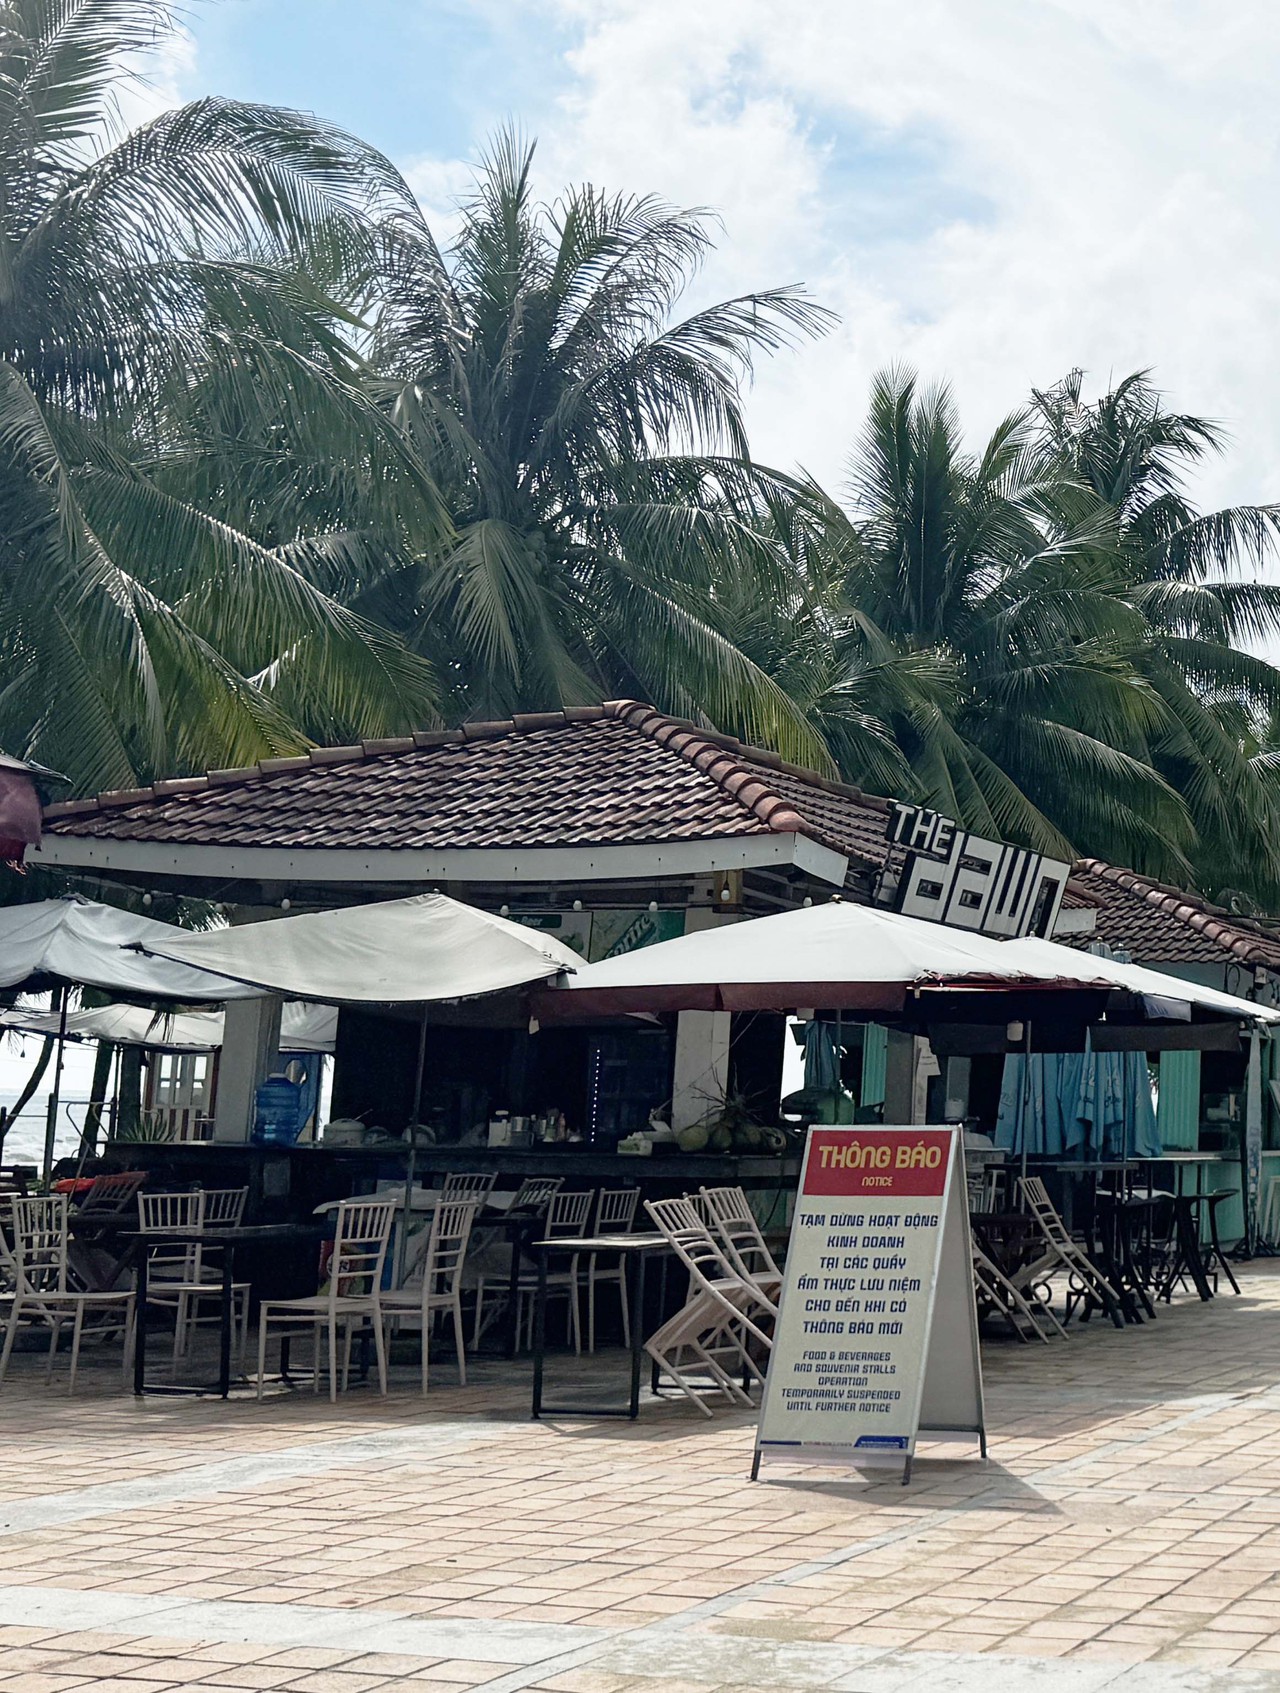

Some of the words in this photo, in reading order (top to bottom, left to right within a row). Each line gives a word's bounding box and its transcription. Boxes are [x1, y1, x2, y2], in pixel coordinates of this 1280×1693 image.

[893, 803, 955, 855] THE
[819, 1140, 891, 1168] THÔNG
[895, 1140, 942, 1168] BÁO
[861, 1176, 893, 1186] NOTICE
[800, 1214, 826, 1228] TẠM
[868, 1214, 901, 1229] HOẠT
[904, 1212, 938, 1229] ĐỘNG
[827, 1235, 858, 1248] KINH
[862, 1236, 905, 1248] DOANH
[820, 1256, 839, 1271] TẠI
[843, 1254, 868, 1269] CÁC
[888, 1276, 921, 1294] NIỆM
[805, 1299, 831, 1312] CHO
[835, 1296, 860, 1312] ĐẾN
[864, 1300, 886, 1312] KHI
[890, 1298, 907, 1313] CÓ
[803, 1318, 844, 1334] THÔNG
[848, 1320, 874, 1334] BÁO
[803, 1350, 827, 1360] FOOD
[838, 1351, 891, 1361] BEVERAGES
[794, 1363, 813, 1373] AND
[815, 1363, 860, 1374] SOUVENIR
[862, 1364, 896, 1374] STALLS
[818, 1376, 868, 1386] OPERATION
[782, 1388, 845, 1399] TEMPORARILY
[847, 1389, 901, 1400] SUSPENDED
[786, 1401, 812, 1411] UNTIL
[815, 1402, 856, 1412] FURTHER
[859, 1402, 891, 1413] NOTICE
